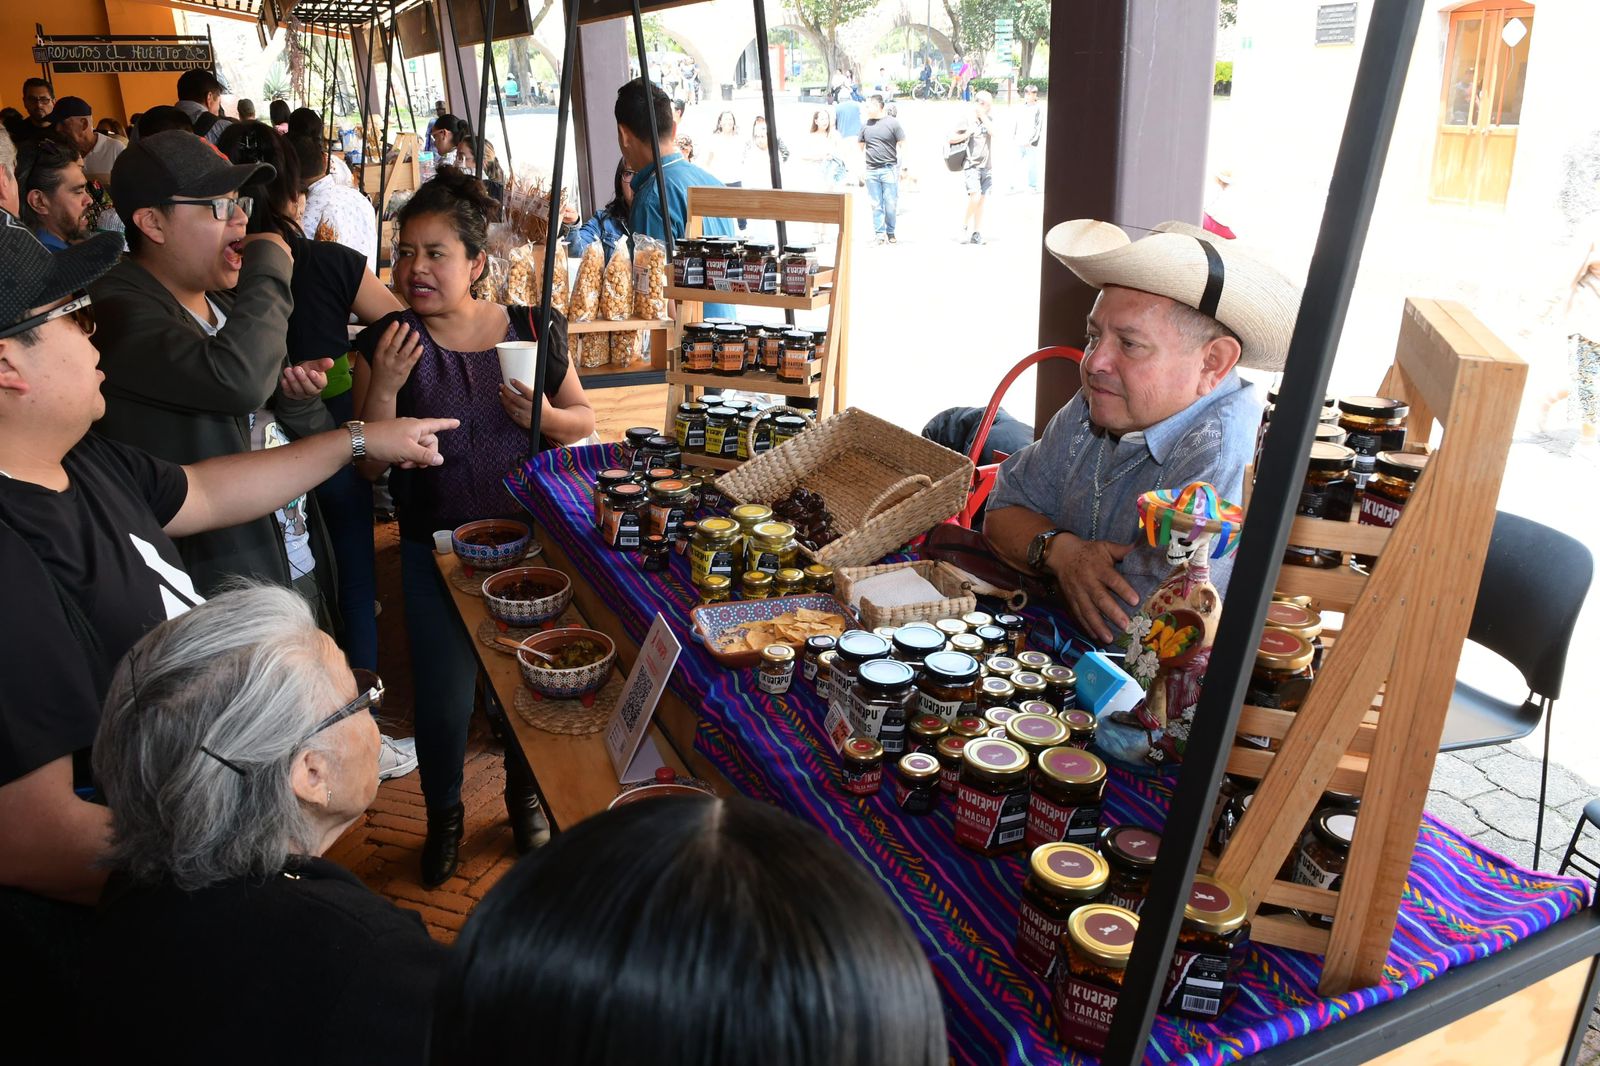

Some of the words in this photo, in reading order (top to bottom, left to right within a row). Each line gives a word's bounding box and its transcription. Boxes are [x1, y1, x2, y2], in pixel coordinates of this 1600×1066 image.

[47, 45, 101, 59] RODUCTOS
[105, 45, 126, 59] EL
[132, 45, 182, 60] HUERTO
[964, 808, 991, 827] MACHA
[1034, 816, 1059, 838] MACHA
[1023, 920, 1056, 951] TARASCA
[1074, 1002, 1114, 1025] TARASC
